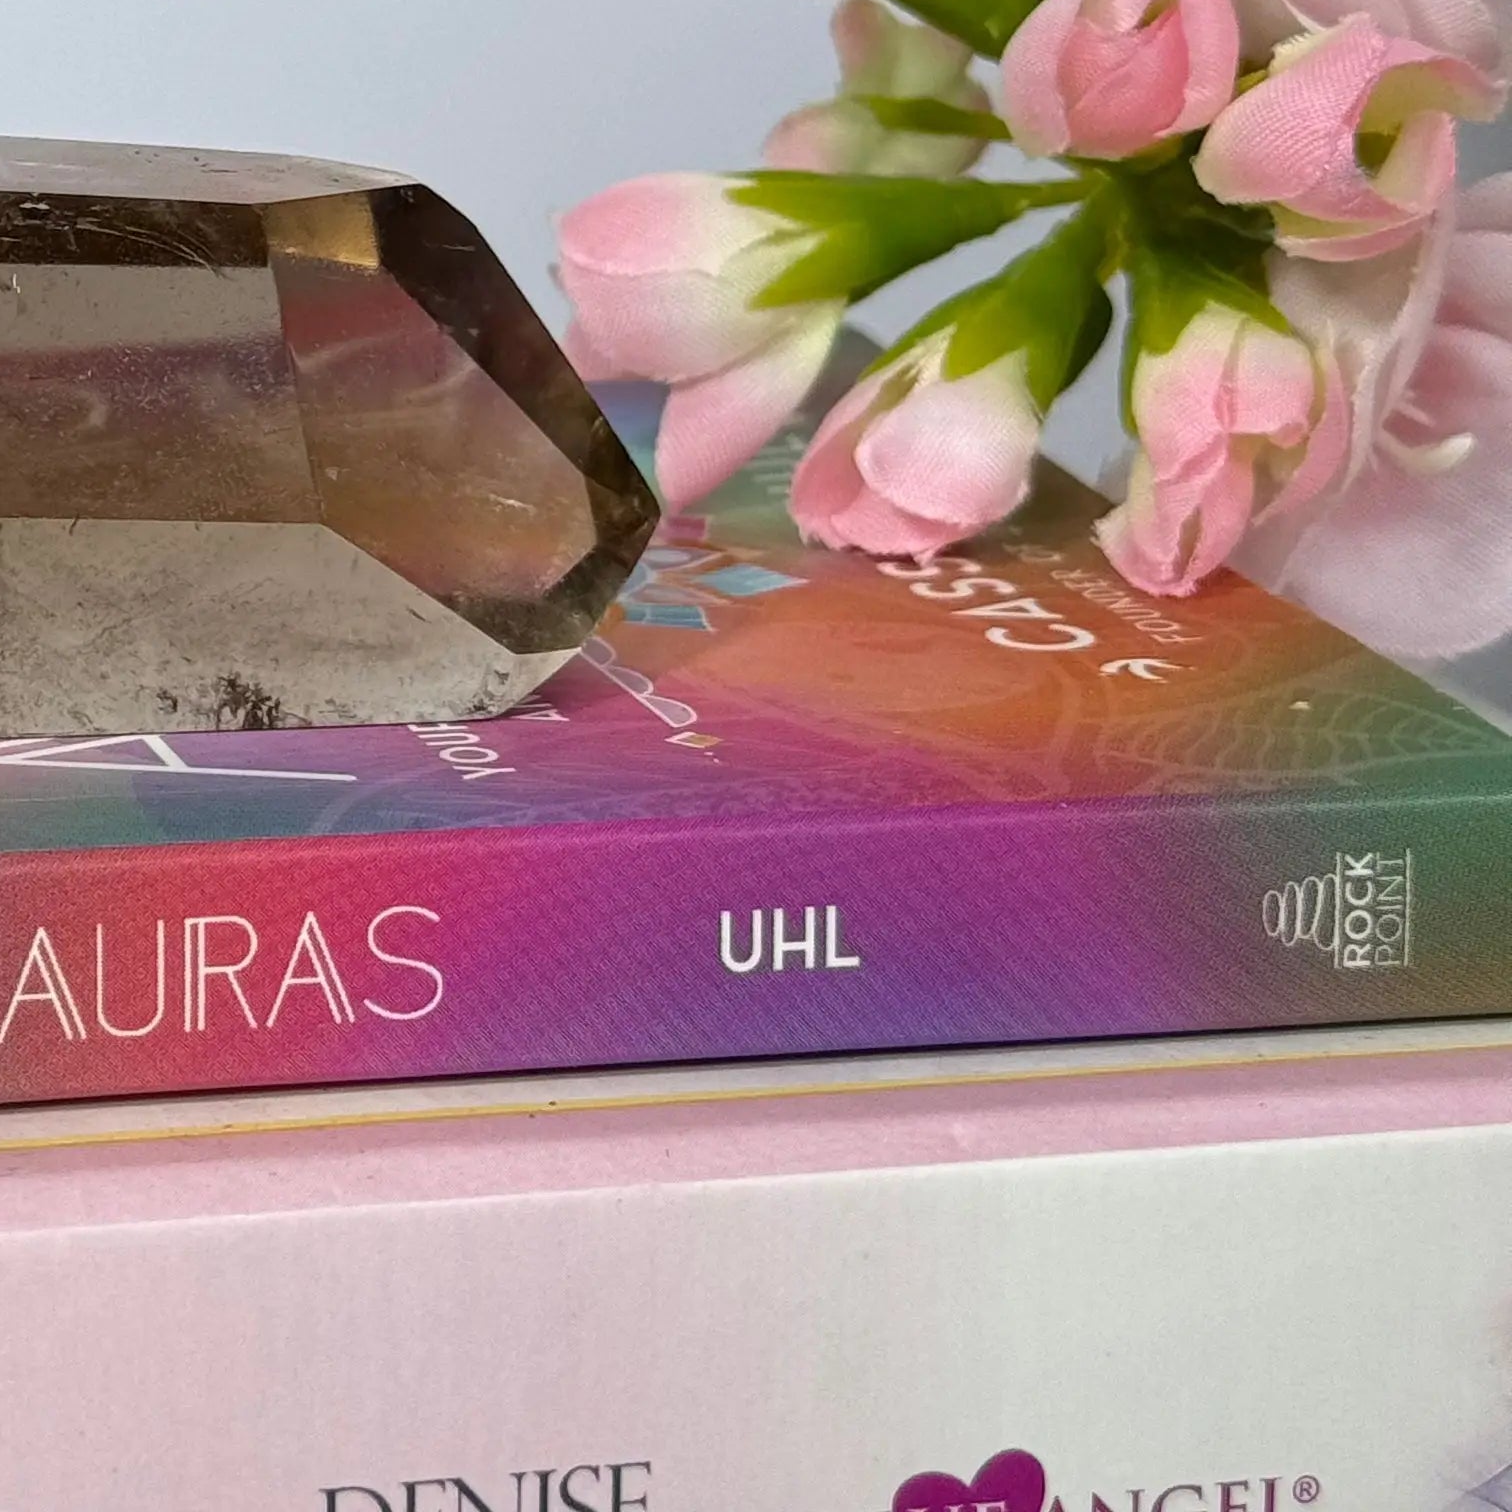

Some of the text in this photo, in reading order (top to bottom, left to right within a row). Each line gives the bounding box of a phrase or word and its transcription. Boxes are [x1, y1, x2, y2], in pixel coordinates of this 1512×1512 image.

[1050, 567, 1203, 644] FOUNDER
[720, 904, 861, 973] UHL
[1343, 851, 1374, 968] ROCK
[1374, 851, 1404, 966] POINT
